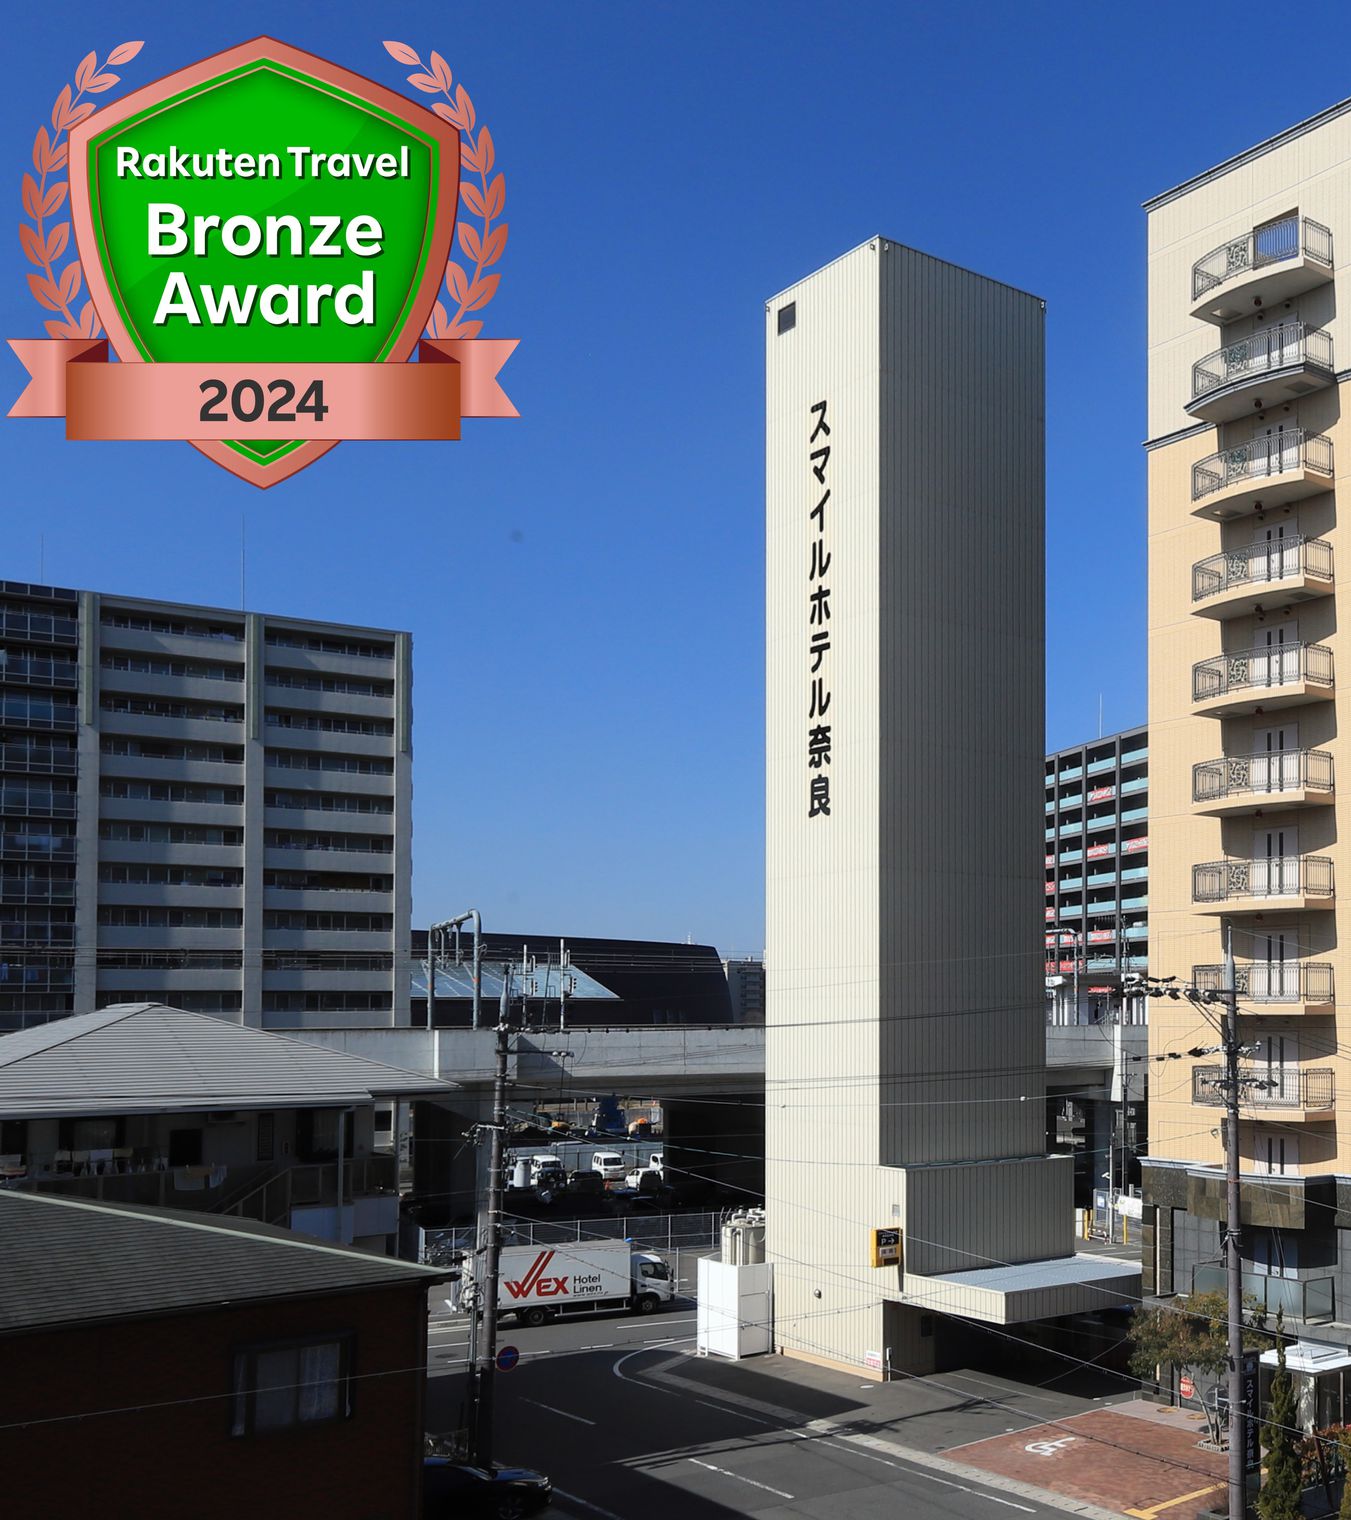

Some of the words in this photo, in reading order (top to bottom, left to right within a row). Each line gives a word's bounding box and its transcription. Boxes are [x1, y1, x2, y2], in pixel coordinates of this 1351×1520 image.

[808, 400, 832, 819] スマイルホテル奈良
[503, 1250, 569, 1299] WEX
[573, 1274, 601, 1285] Hotel
[573, 1284, 602, 1294] Linen
